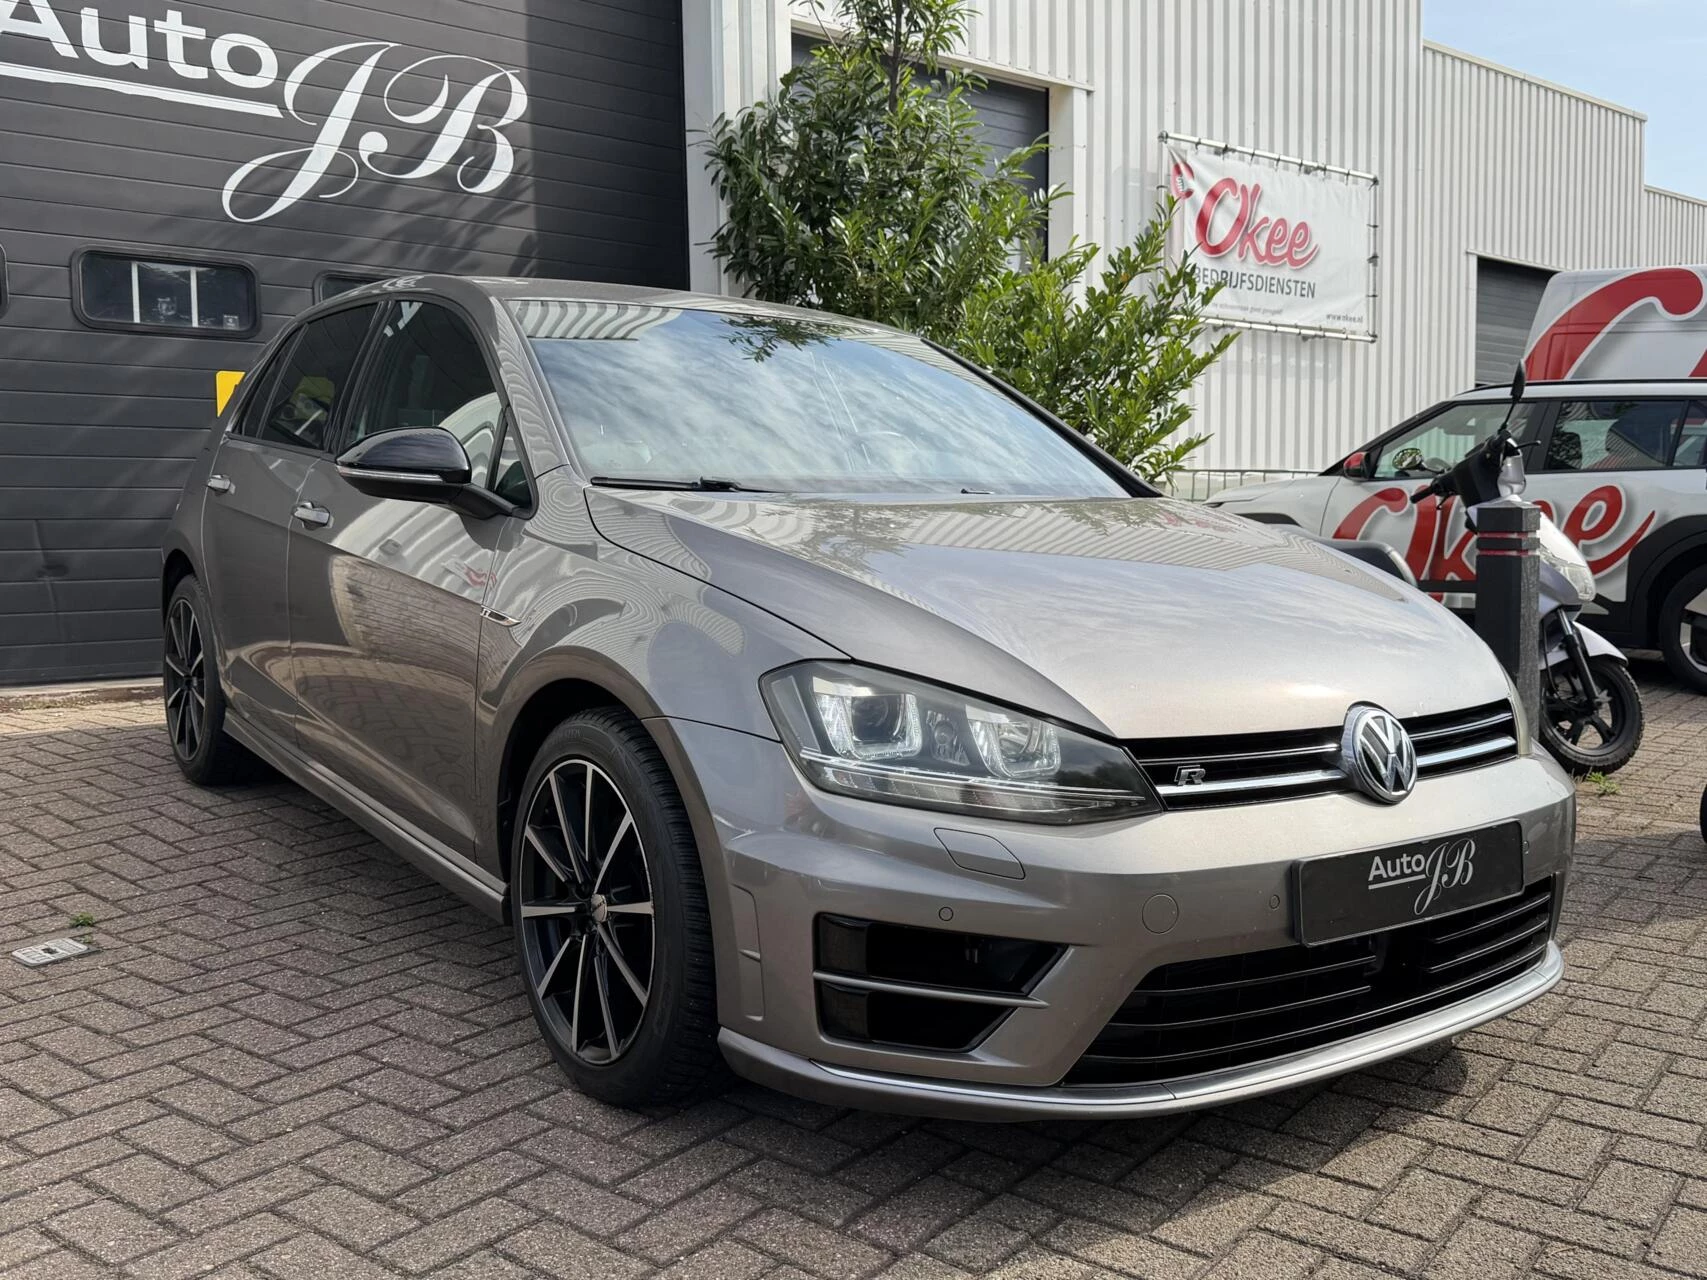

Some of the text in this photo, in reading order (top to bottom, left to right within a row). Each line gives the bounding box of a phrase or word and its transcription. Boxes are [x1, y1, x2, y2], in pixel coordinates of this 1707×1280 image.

[0, 0, 278, 88] Auto
[1174, 765, 1206, 786] R
[1368, 852, 1426, 882] Auto
